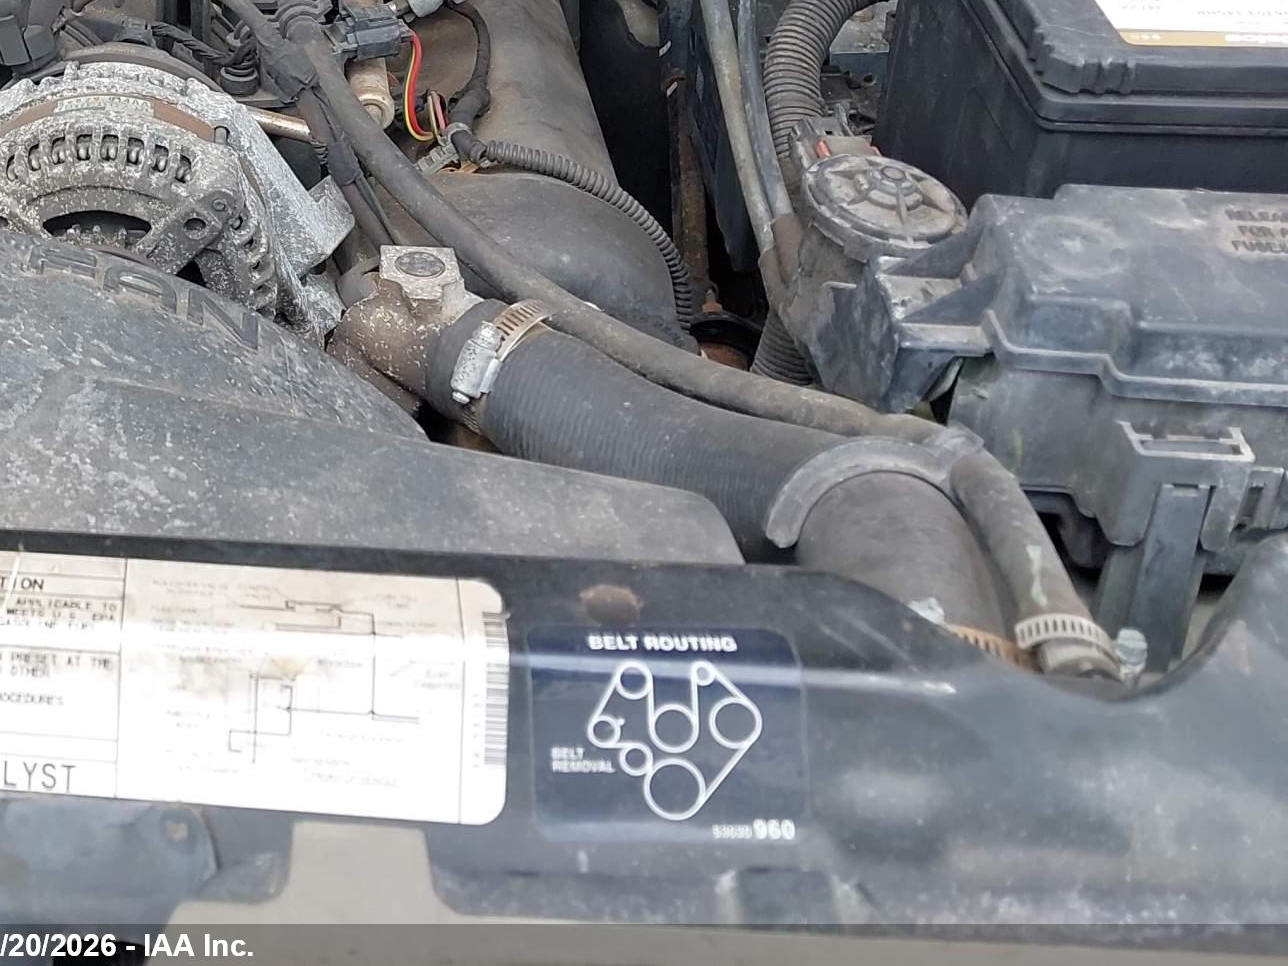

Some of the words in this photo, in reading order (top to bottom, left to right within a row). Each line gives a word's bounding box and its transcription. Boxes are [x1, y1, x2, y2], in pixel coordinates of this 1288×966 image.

[22, 244, 260, 351] FAN
[588, 635, 638, 650] BELT
[643, 636, 738, 652] ROUTING
[551, 747, 584, 761] BELT
[552, 760, 616, 774] REMOVAL
